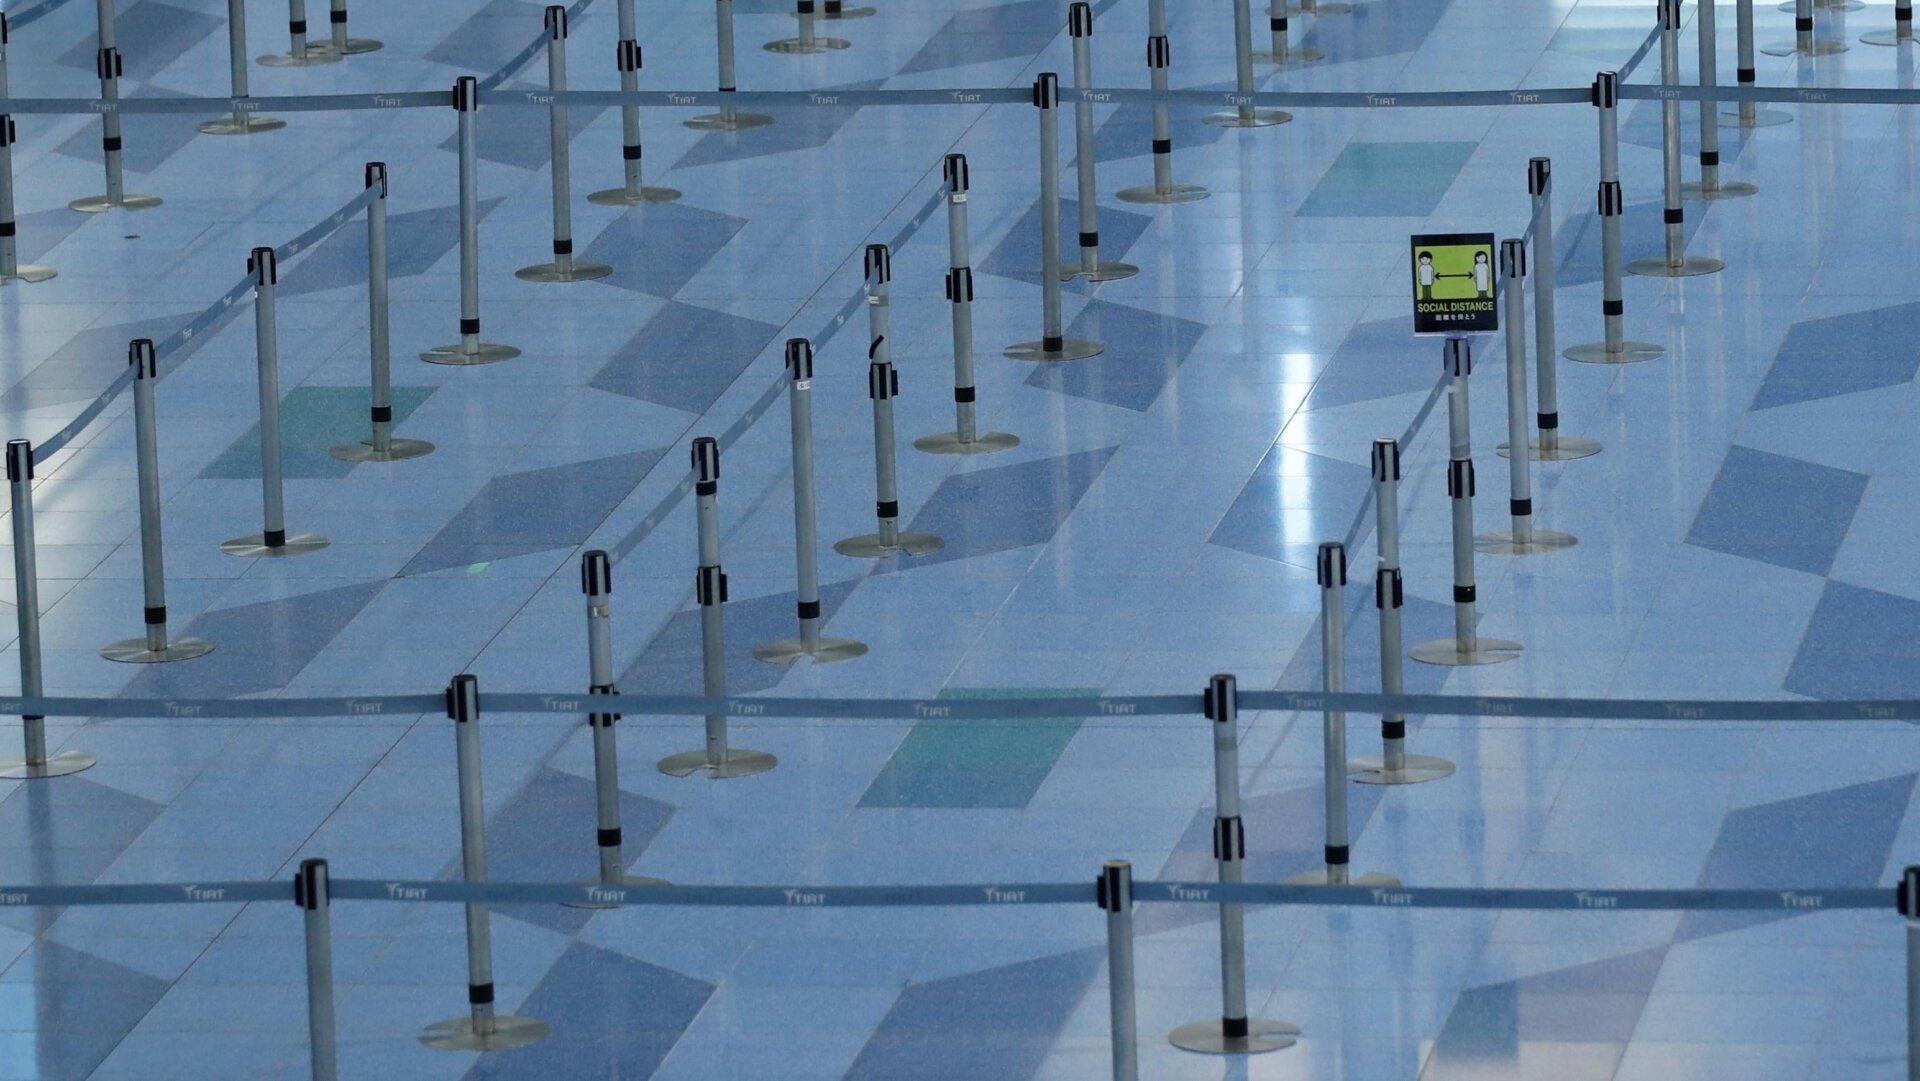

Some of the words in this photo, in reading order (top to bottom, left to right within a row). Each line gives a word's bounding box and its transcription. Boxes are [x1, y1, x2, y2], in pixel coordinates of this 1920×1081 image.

[378, 98, 402, 107] TIAT
[531, 96, 555, 104] TIAT
[673, 95, 697, 104] TIAT
[815, 95, 840, 105] TIAT
[958, 93, 981, 103] TIAT
[1087, 93, 1111, 102] TIAT
[1228, 96, 1253, 105] TIAT
[1372, 96, 1396, 105] TIAT
[1515, 93, 1539, 102] TIAT
[236, 101, 259, 111] TIAT
[1417, 303, 1450, 313] SOCIAL
[1451, 302, 1494, 312] DISTANCE
[172, 706, 202, 716] TIAT
[353, 703, 383, 713] TIAT
[552, 701, 581, 711] TIAT
[736, 704, 765, 715] TIAT
[1107, 704, 1137, 715] TIAT
[922, 707, 951, 717] TIAT
[193, 889, 225, 899] TIAT
[397, 888, 429, 899] TIAT
[595, 891, 627, 901] TIAT
[994, 891, 1026, 902] TIAT
[1178, 890, 1210, 901] TIAT
[794, 894, 826, 905] TIAT
[1382, 894, 1414, 905] TIAT
[1585, 897, 1618, 908] TIAT
[1790, 896, 1823, 907] TIAT
